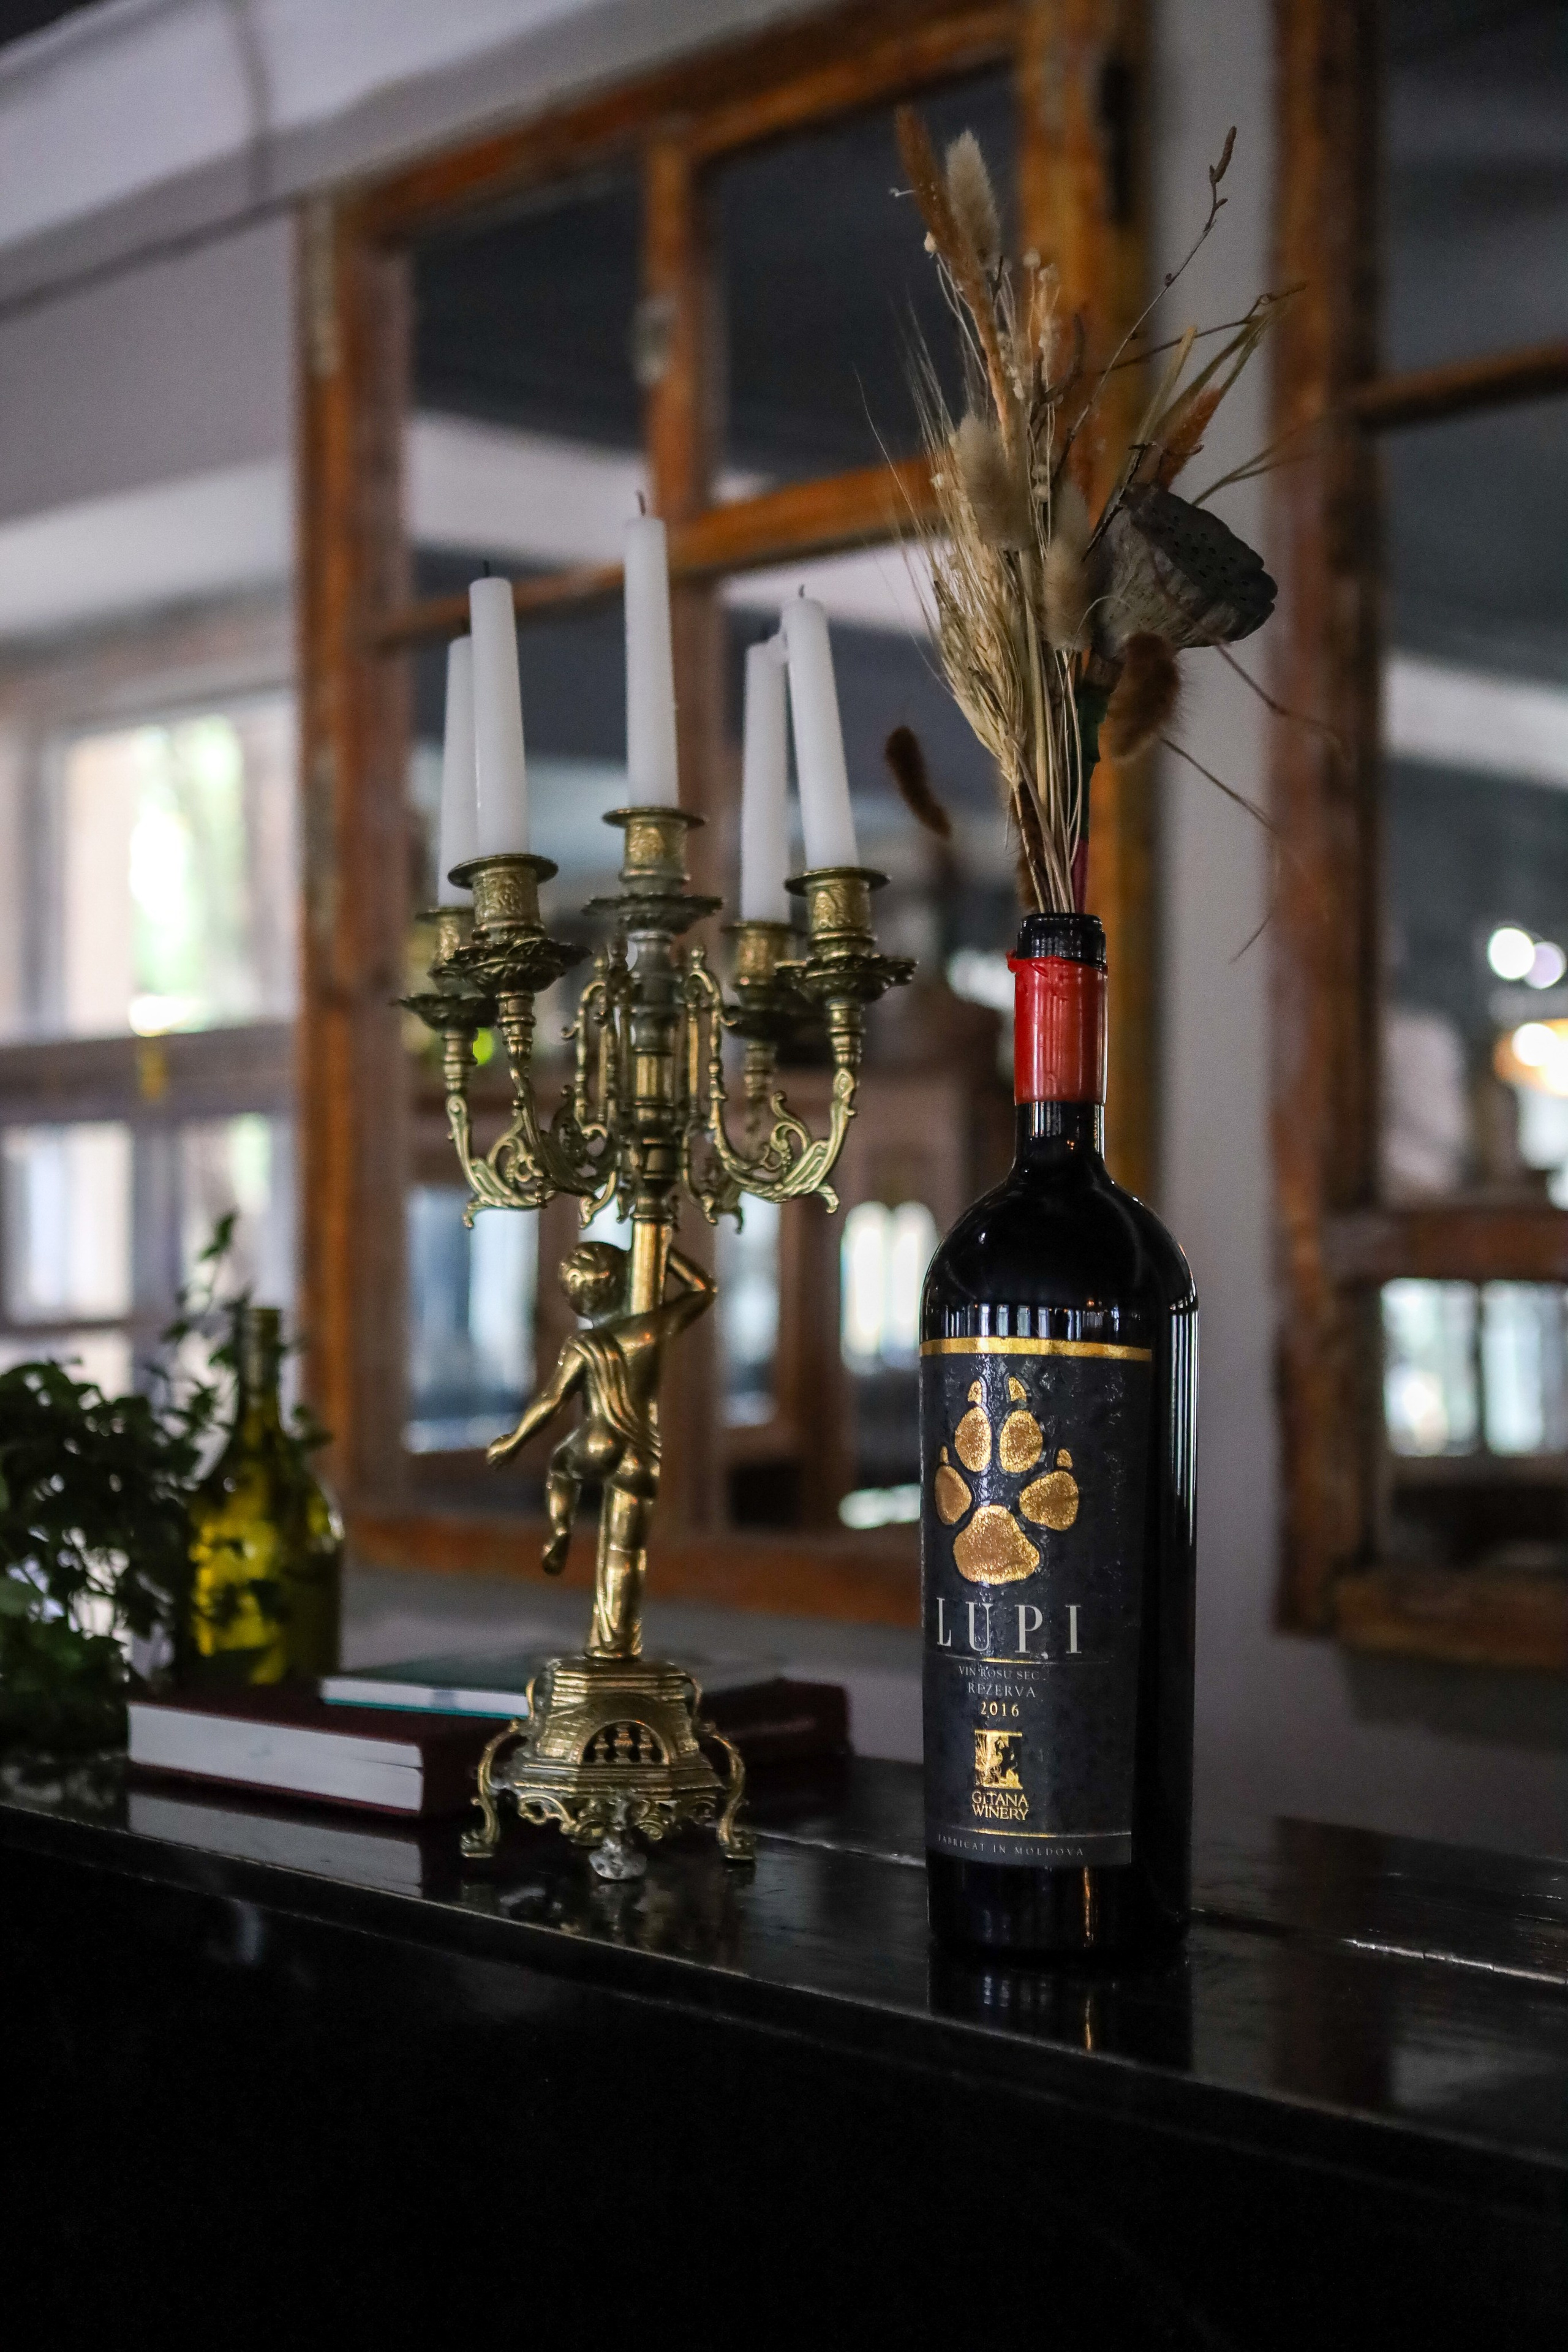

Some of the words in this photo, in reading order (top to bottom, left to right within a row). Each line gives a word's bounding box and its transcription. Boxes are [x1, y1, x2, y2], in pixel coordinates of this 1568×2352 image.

[937, 1597, 1082, 1654] LUPI
[959, 1665, 976, 1676] VIN
[1017, 1670, 1040, 1680] SEC
[968, 1681, 1036, 1698] REZERVA
[981, 1701, 1019, 1717] 2016
[971, 1790, 1029, 1807] GITANA
[971, 1804, 1029, 1820] WINERY
[1015, 1846, 1083, 1856] MOLDOVA
